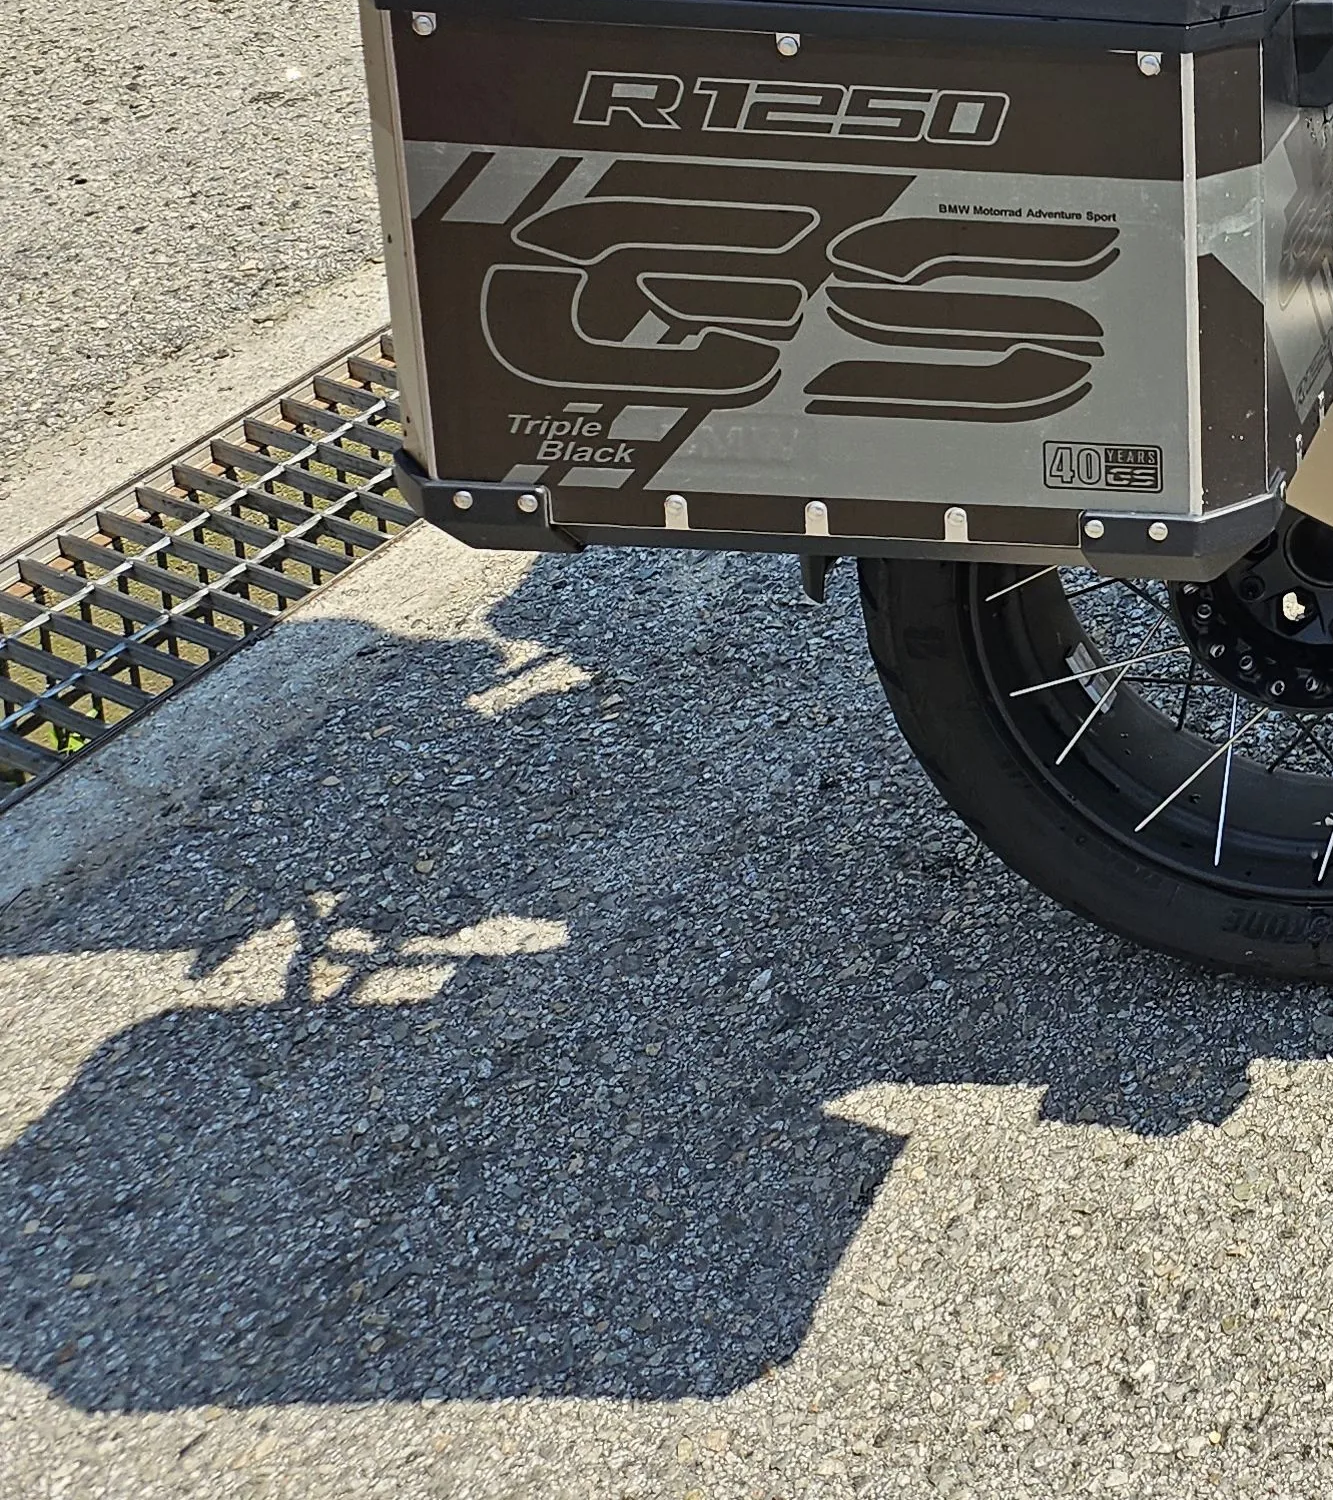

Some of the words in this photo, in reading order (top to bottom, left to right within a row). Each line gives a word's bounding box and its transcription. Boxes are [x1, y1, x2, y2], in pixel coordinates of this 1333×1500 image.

[573, 70, 682, 130] R
[693, 77, 1010, 146] 1250
[938, 203, 970, 215] BMW
[973, 205, 1022, 218] Motorrad
[1026, 208, 1083, 221] Adventure
[1086, 211, 1117, 223] Sport
[480, 196, 1121, 423] GS
[507, 413, 602, 439] Triple
[536, 440, 636, 464] Black
[1050, 447, 1102, 485] 40
[1106, 449, 1156, 464] YEARS
